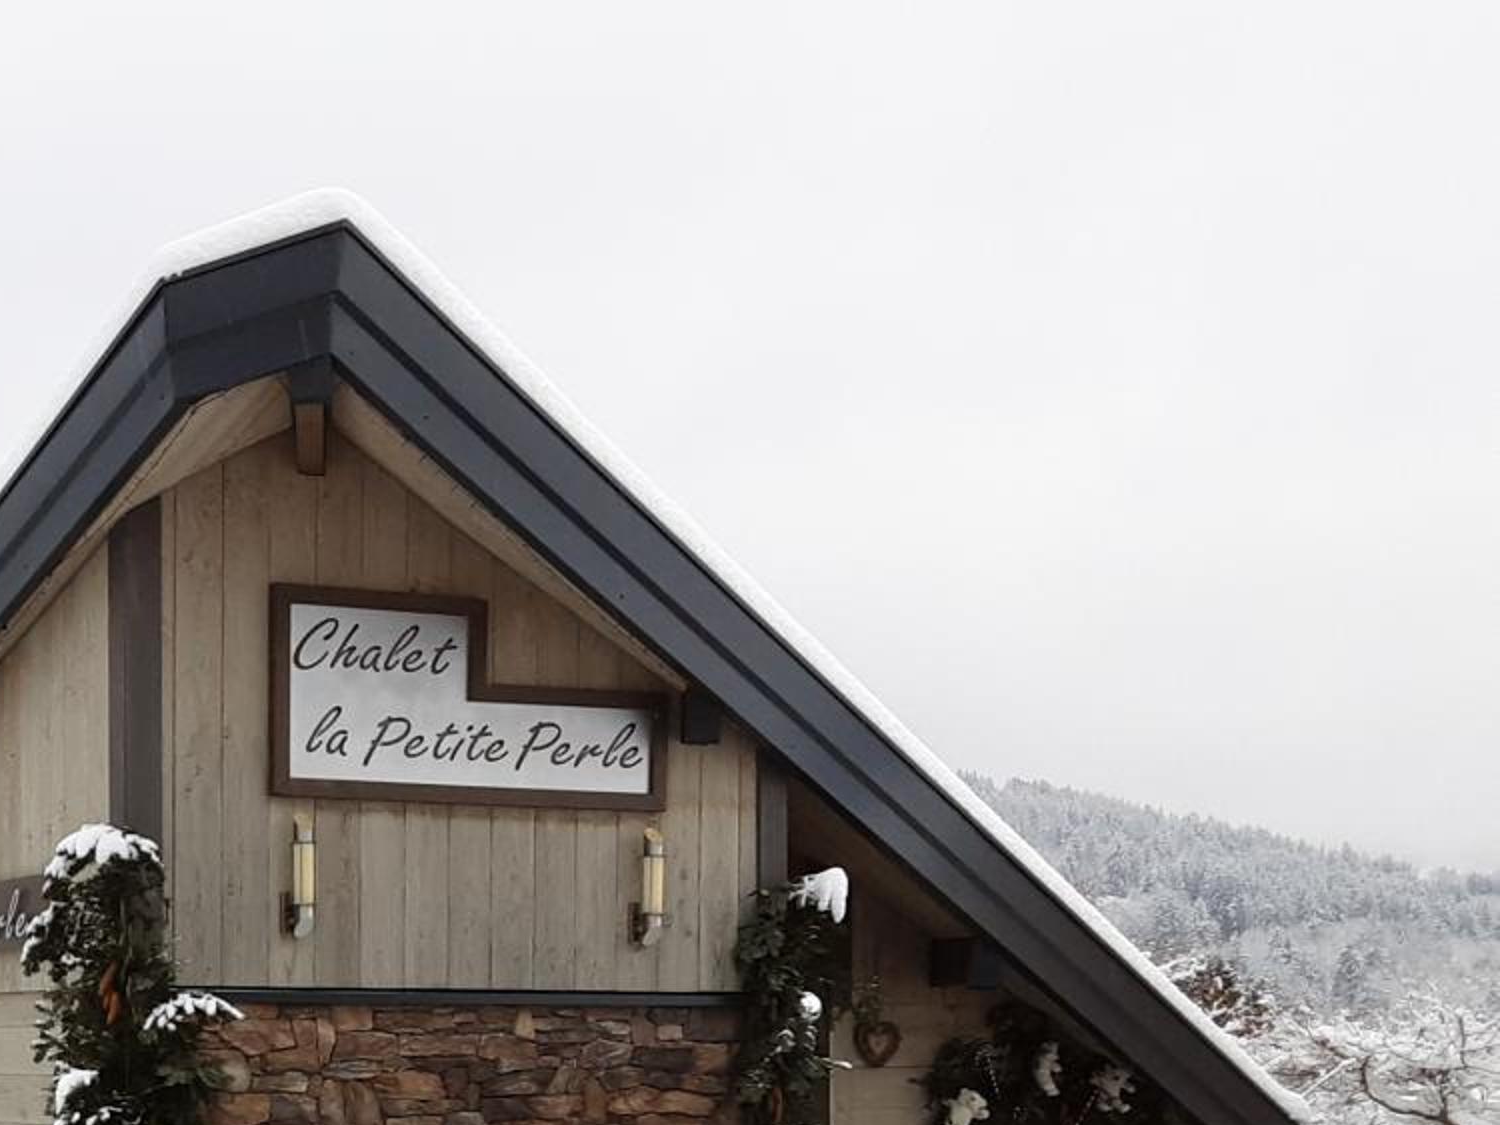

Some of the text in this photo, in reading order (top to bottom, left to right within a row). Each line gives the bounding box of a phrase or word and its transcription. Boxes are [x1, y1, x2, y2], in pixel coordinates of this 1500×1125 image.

[293, 617, 458, 675] Chalet
[305, 705, 643, 771] la Petite Perle
